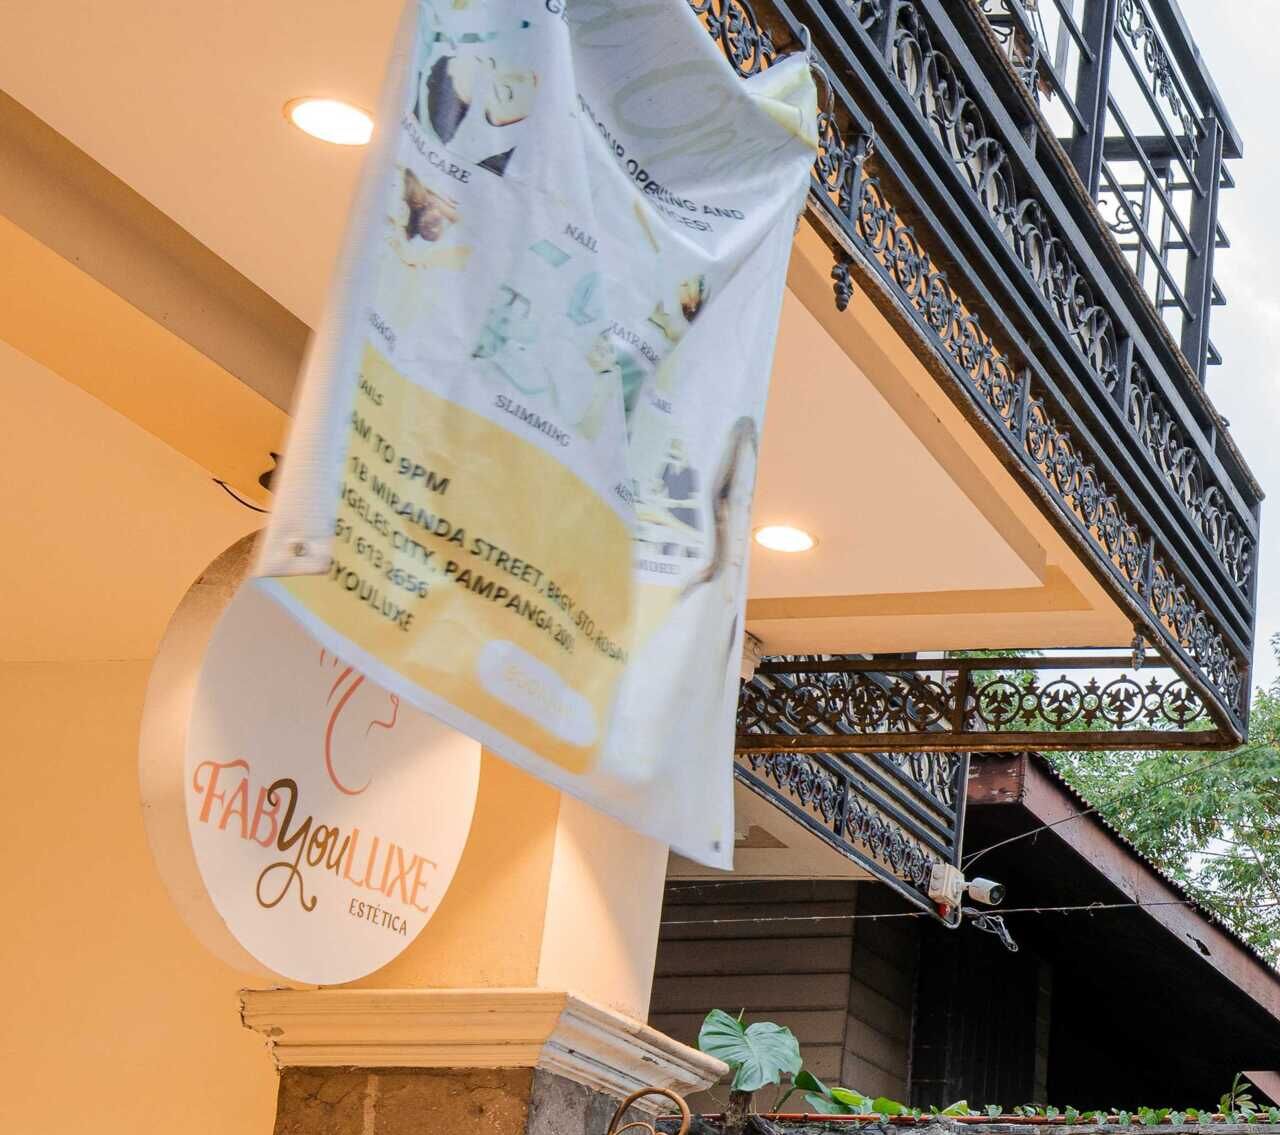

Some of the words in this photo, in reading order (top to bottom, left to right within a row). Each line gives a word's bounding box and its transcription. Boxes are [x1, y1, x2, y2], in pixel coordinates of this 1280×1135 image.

[426, 150, 472, 184] CARE
[703, 204, 745, 220] AND
[494, 394, 571, 447] SLIMMING
[397, 456, 450, 496] 9PM
[370, 475, 466, 549] MIRANDA
[444, 560, 554, 634] PAMPANGA
